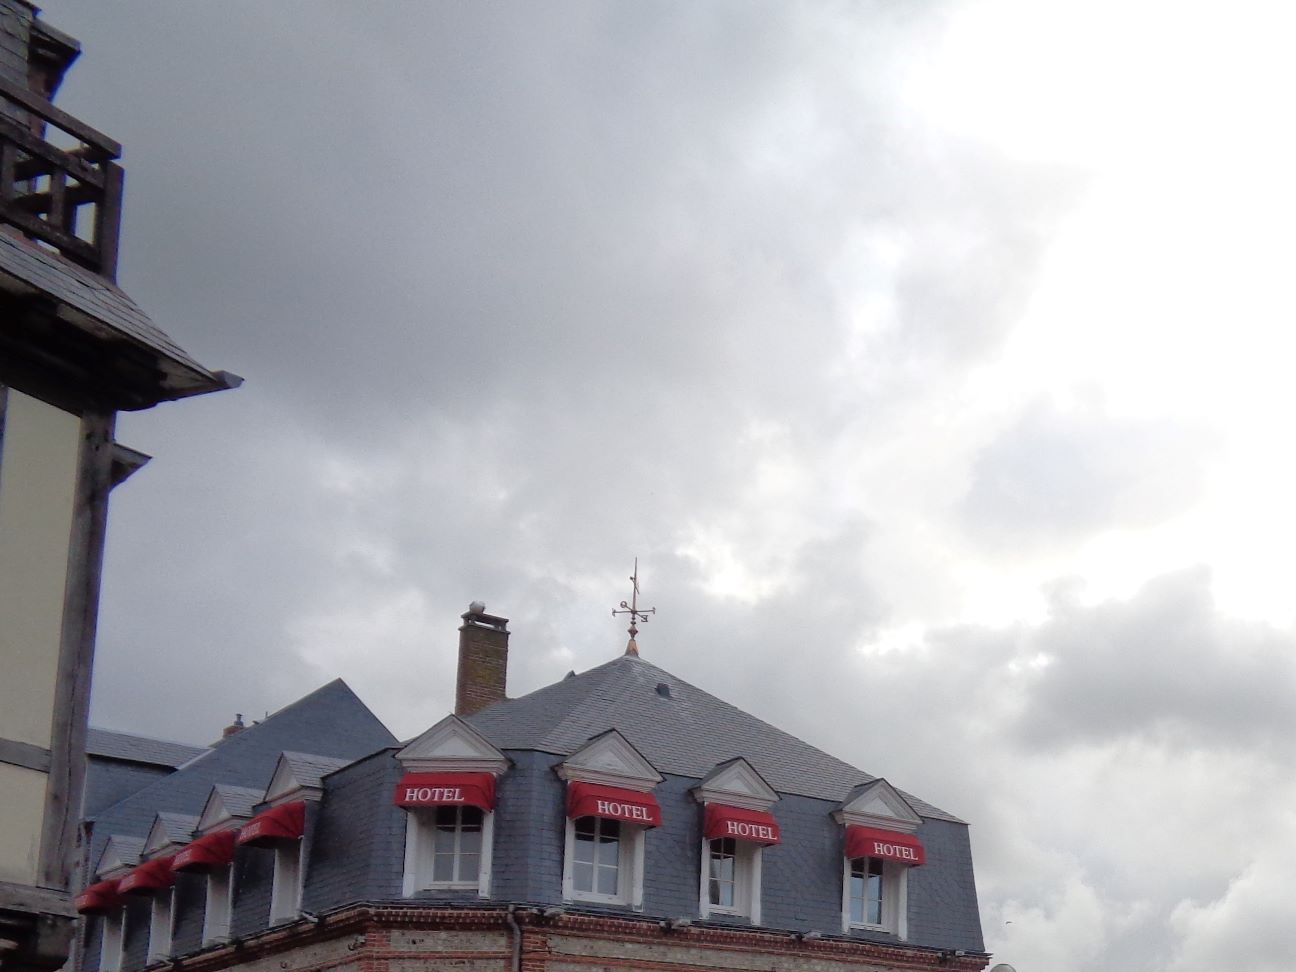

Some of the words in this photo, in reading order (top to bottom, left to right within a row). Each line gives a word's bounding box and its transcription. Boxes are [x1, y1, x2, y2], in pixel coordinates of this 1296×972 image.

[405, 787, 465, 802] HOTEL
[597, 800, 653, 821] HOTEL
[726, 820, 778, 840] HOTEL
[874, 842, 918, 861] HOTEL
